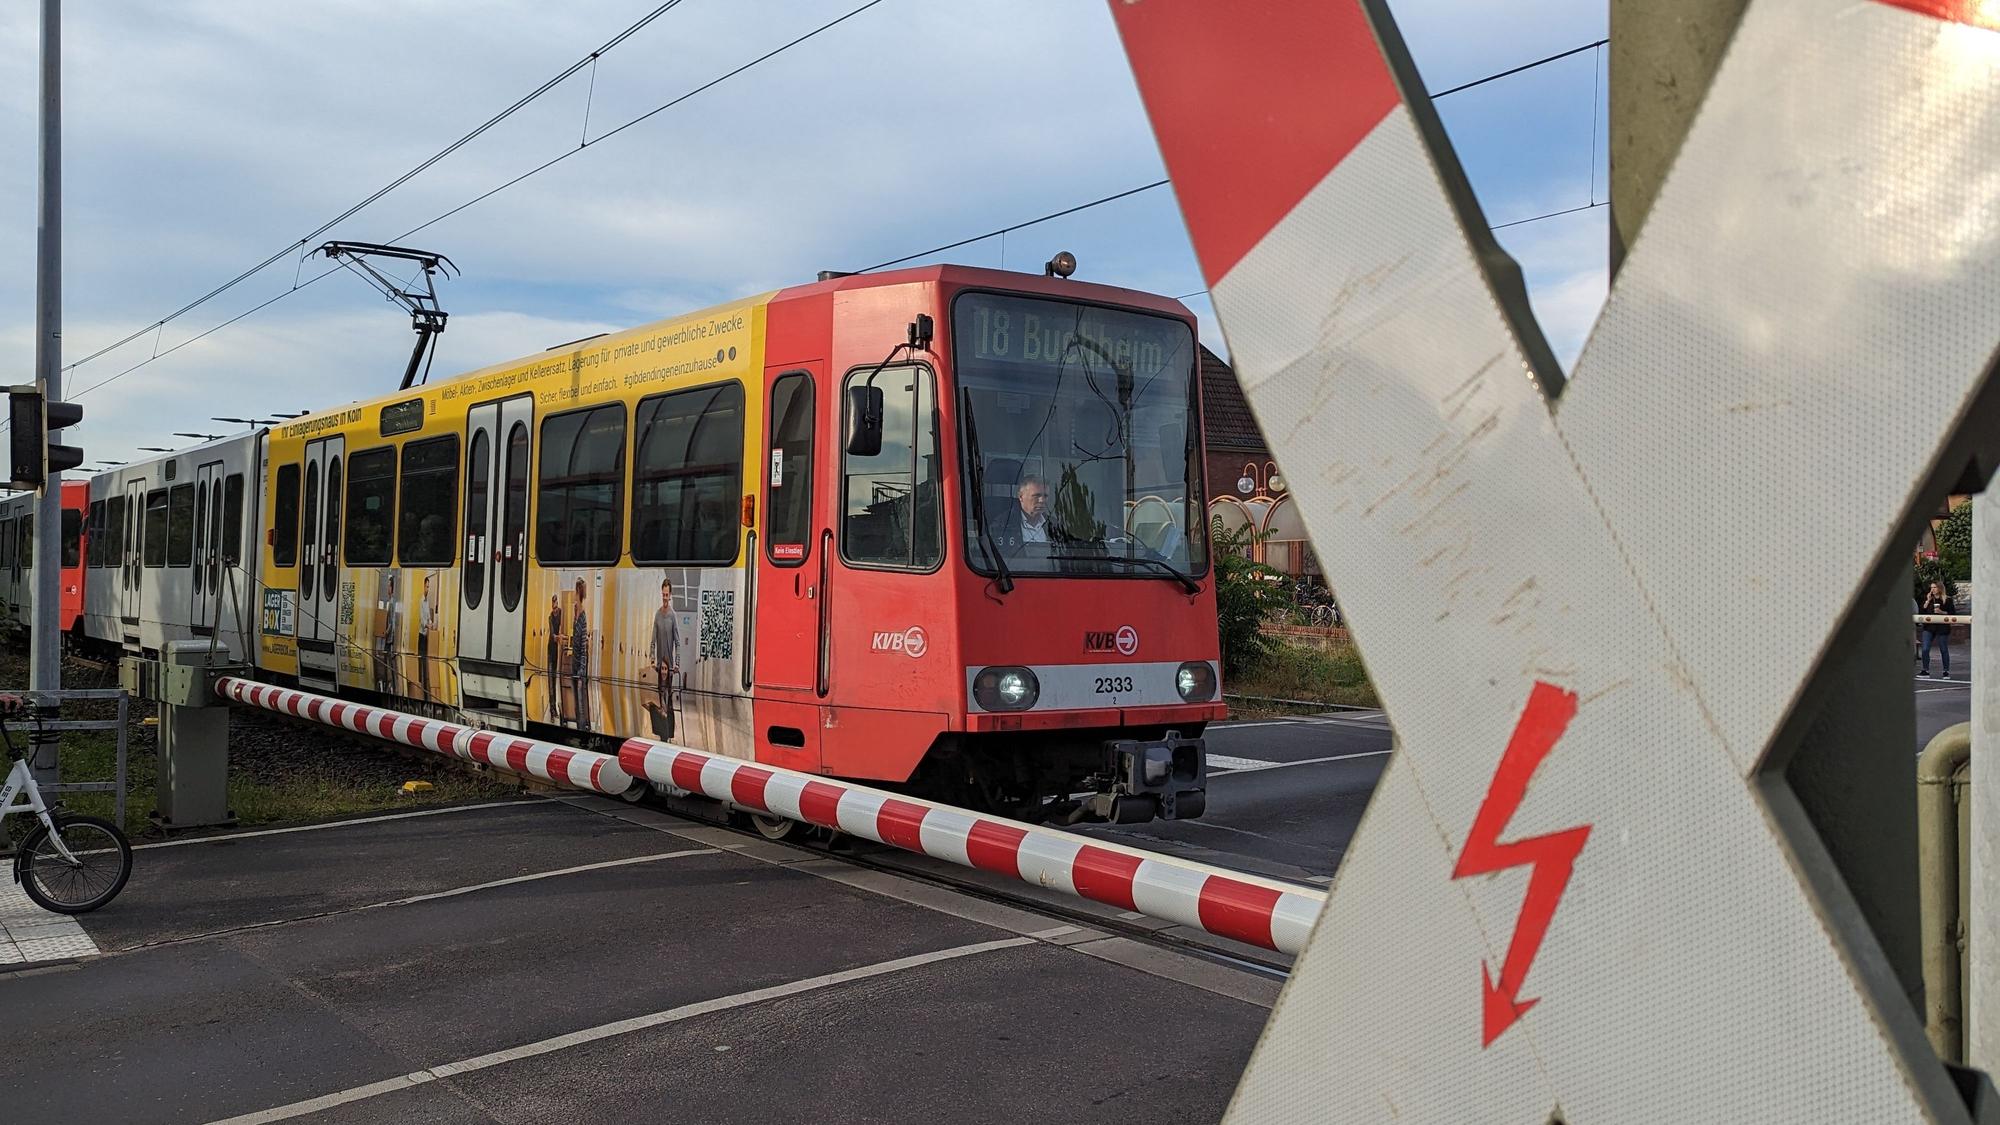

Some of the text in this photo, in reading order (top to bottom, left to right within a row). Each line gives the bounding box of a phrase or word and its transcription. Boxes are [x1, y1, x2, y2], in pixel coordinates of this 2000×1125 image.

[979, 307, 1162, 373] 18 Buchheim
[478, 374, 517, 393] Zwischenlager
[518, 371, 528, 383] und
[530, 361, 567, 379] Kellerersatz,
[568, 352, 599, 373] Lagerung
[601, 349, 611, 364] für
[614, 341, 639, 364] private
[640, 336, 656, 353] und
[657, 324, 707, 353] gewerbliche
[708, 315, 745, 337] Zwecke.
[540, 356, 717, 405] Sicher, flexibel und einfach. #gibdendingeneinzuhause
[264, 593, 281, 608] LAGER
[263, 608, 281, 630] BOX
[871, 632, 904, 650] KVB
[1085, 631, 1115, 650] KVB
[1095, 676, 1133, 694] 2333
